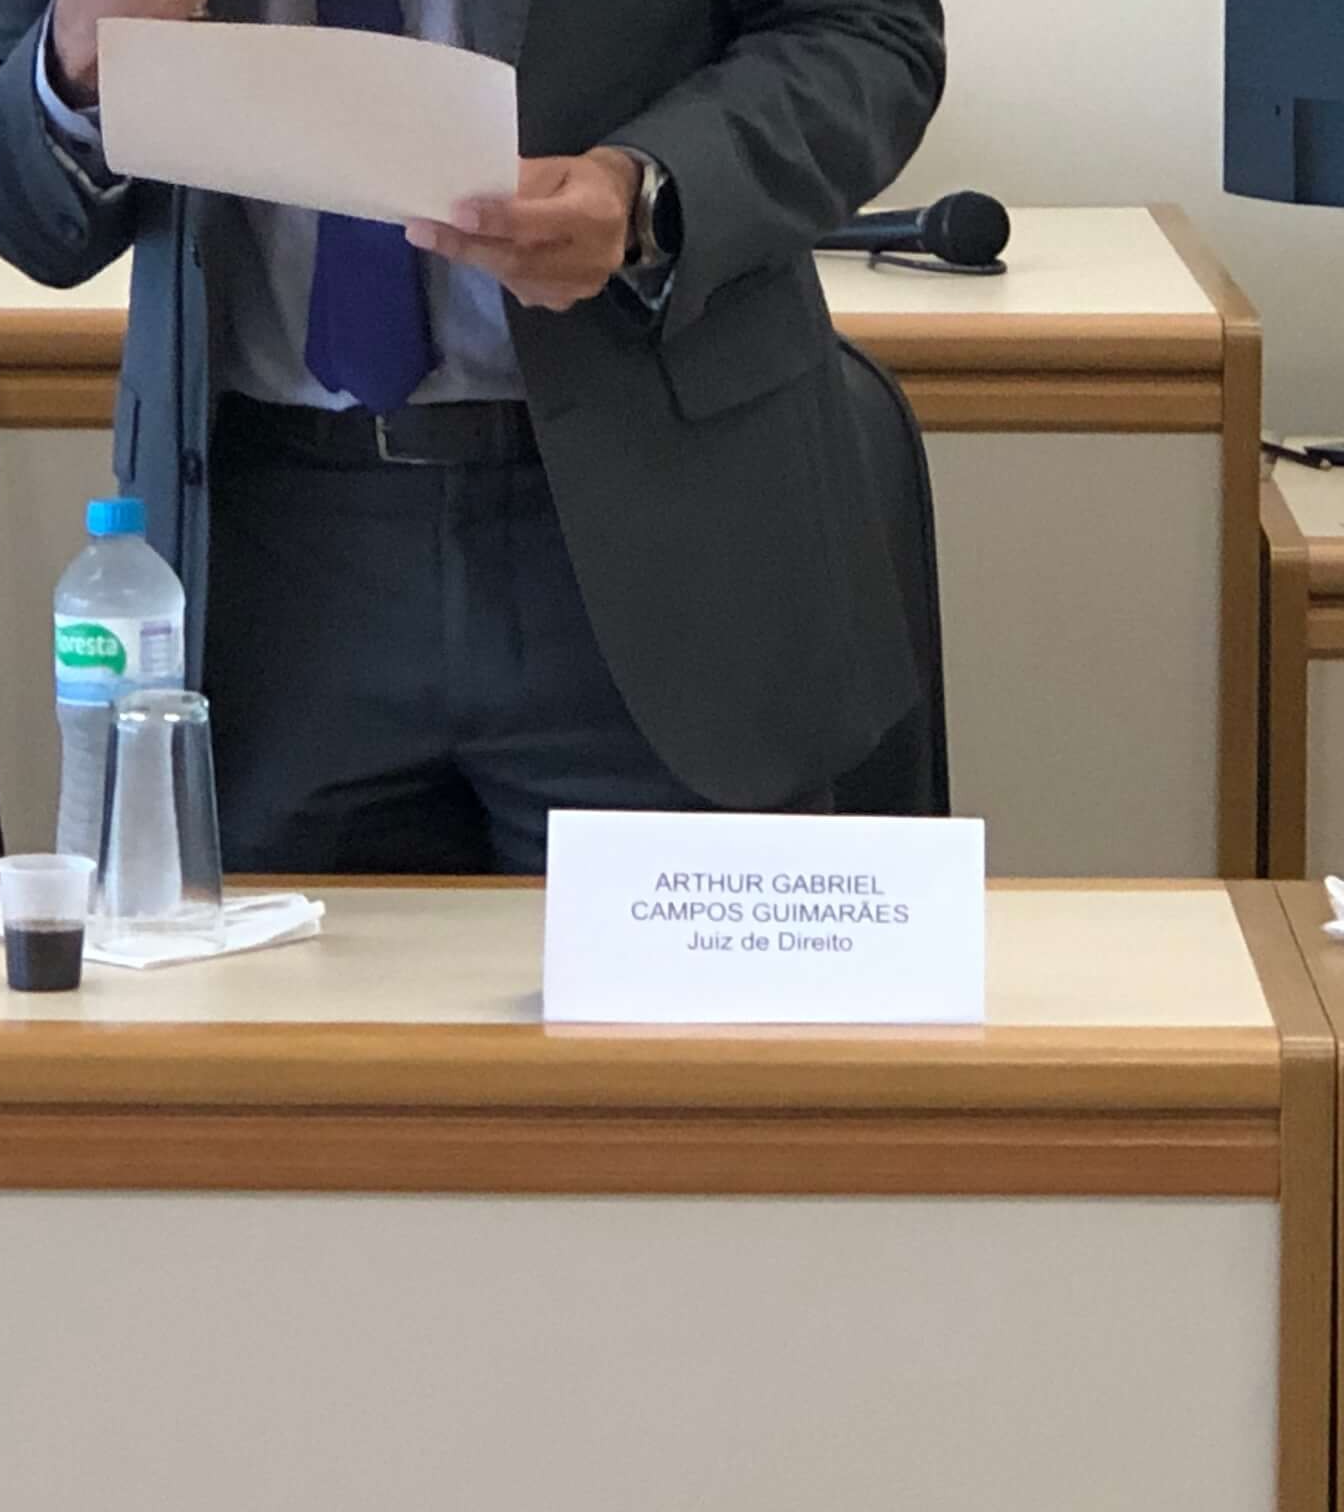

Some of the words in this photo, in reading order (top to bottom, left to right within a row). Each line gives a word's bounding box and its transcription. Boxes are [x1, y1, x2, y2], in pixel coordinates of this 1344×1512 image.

[654, 871, 764, 894] ARTHUR
[771, 873, 885, 896] GABRIEL
[630, 899, 745, 923] CAMPOS
[751, 899, 910, 925] GUIMARÃES
[687, 930, 734, 952] Juiz
[740, 931, 771, 952] de
[777, 930, 854, 953] Direito
